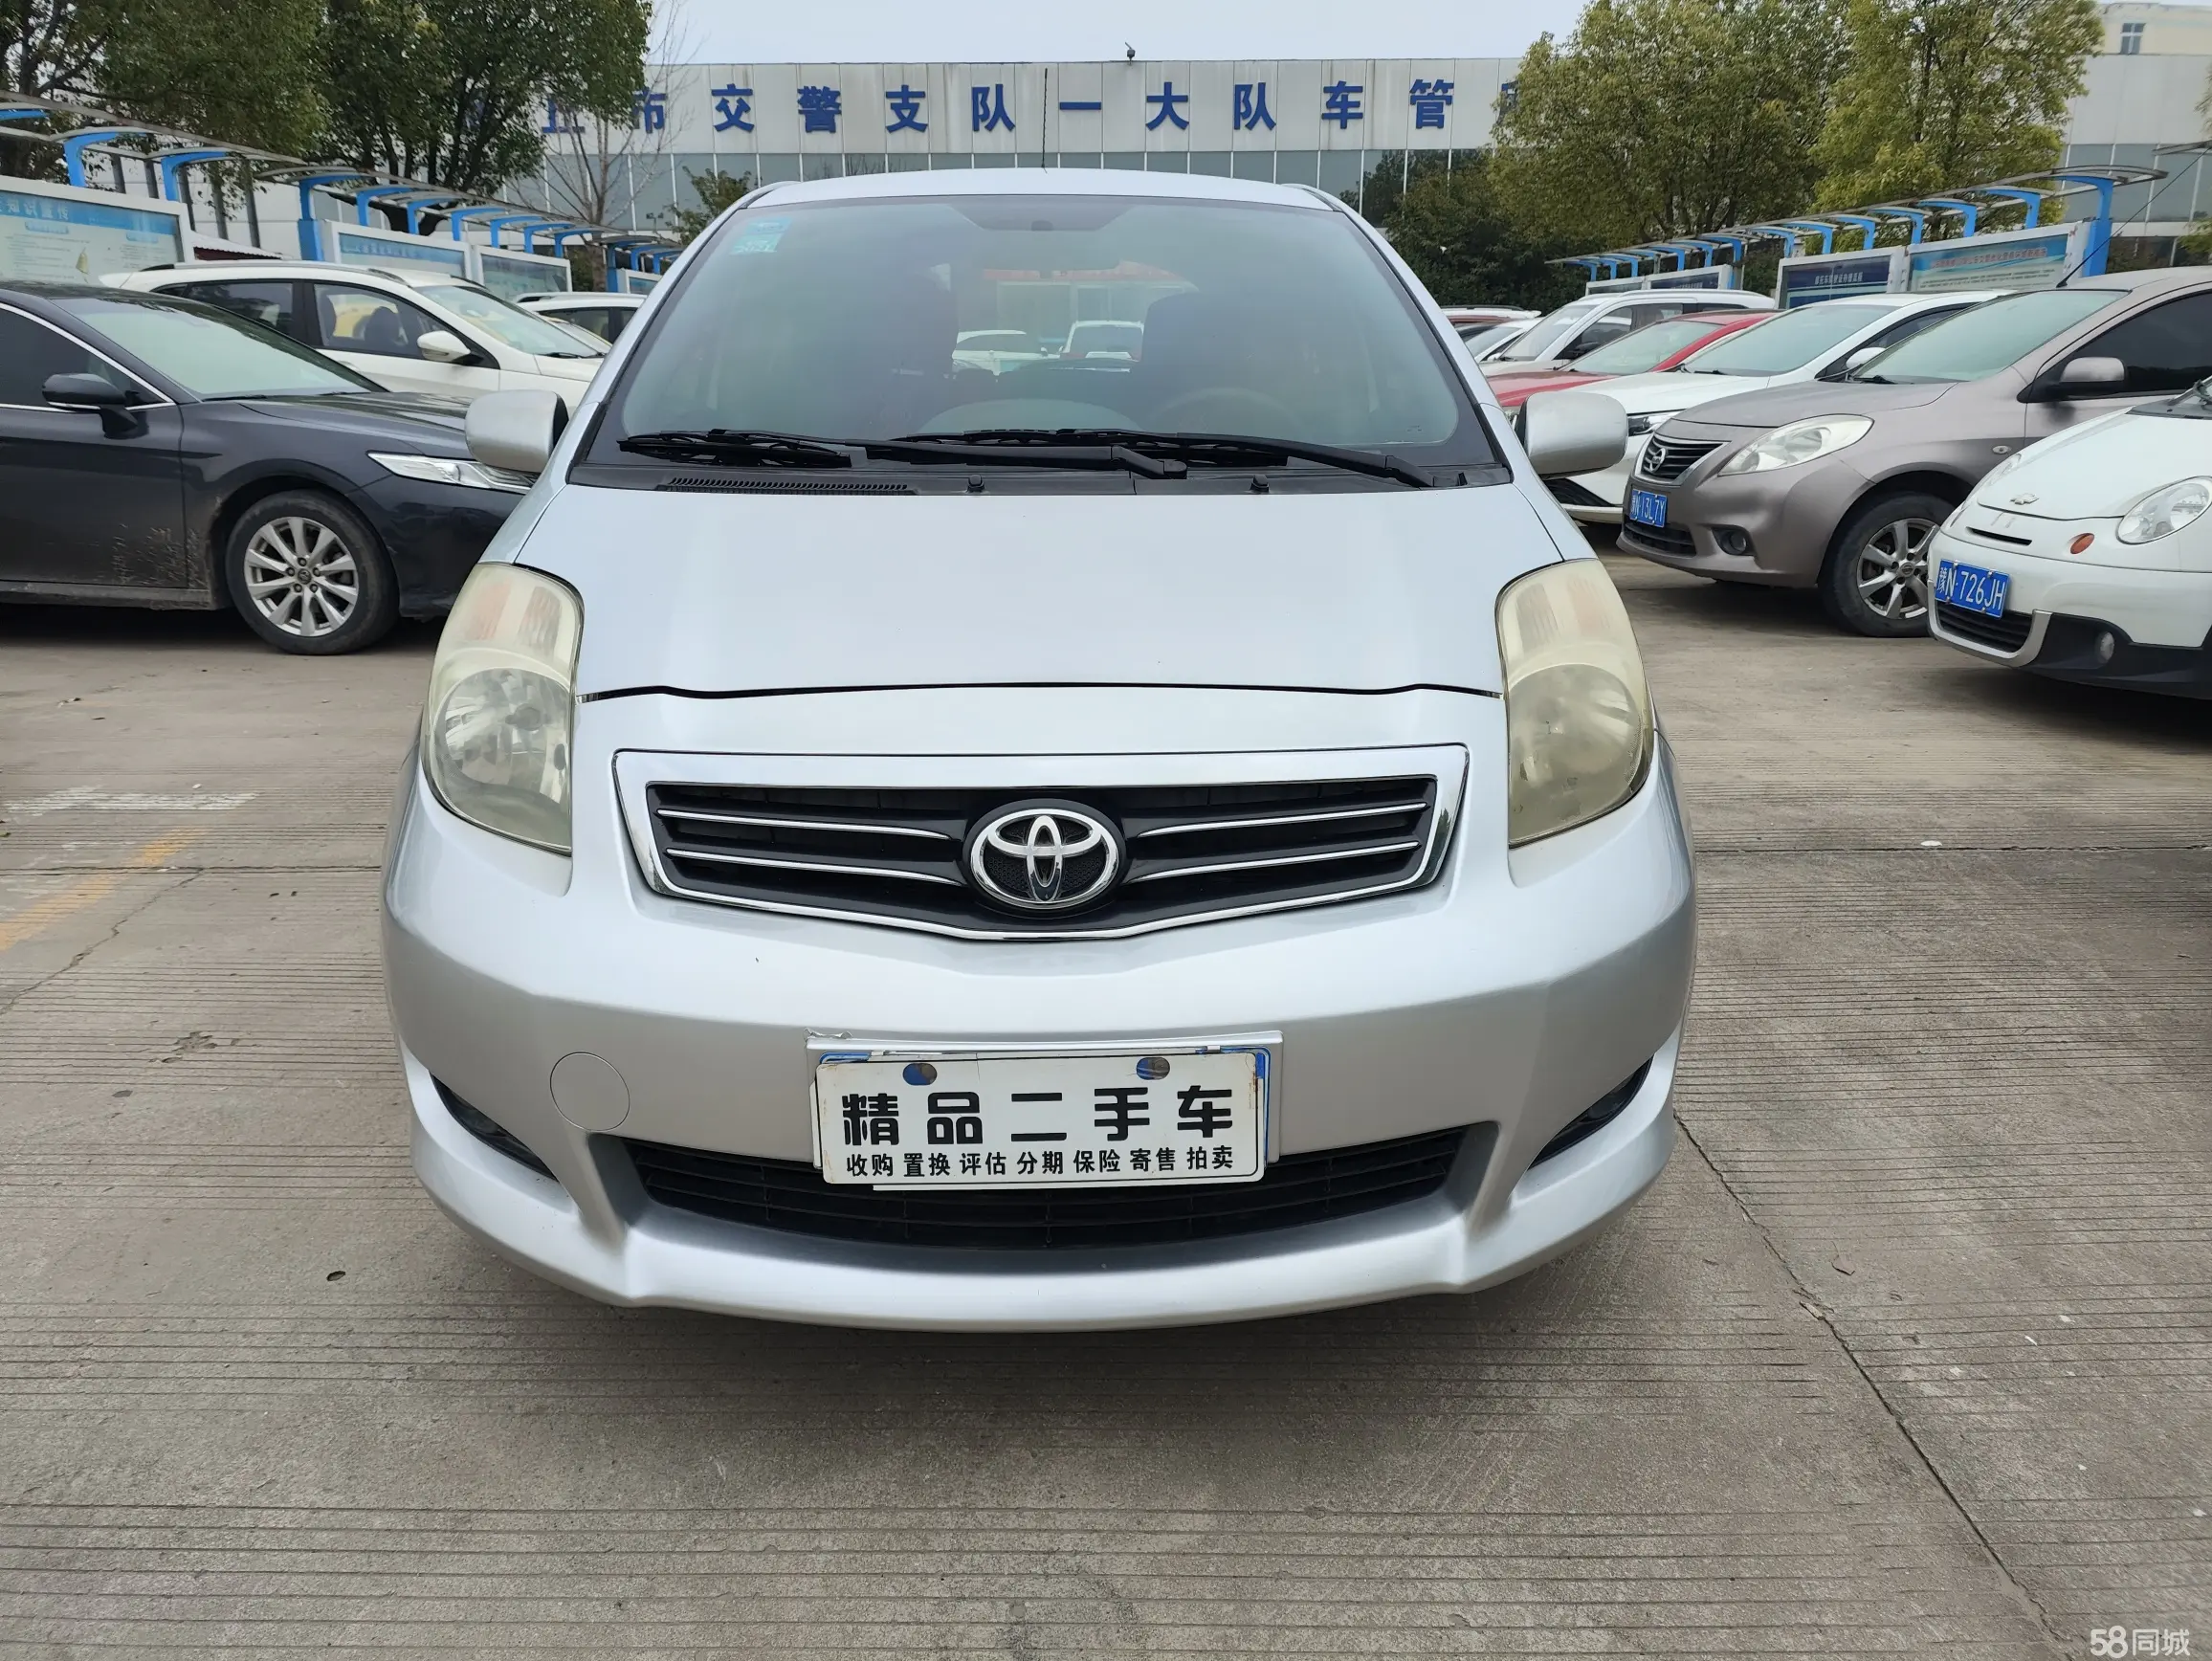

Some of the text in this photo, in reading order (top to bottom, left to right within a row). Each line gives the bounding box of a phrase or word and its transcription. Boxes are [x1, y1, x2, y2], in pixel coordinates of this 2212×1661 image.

[542, 78, 1519, 135] 市交警支队一大队车管
[0, 196, 70, 222] 知识宣传
[842, 1085, 1233, 1146] 精品二手车
[847, 1144, 1233, 1178] 收购 置换 评估 分期 保险 寄售 拍卖
